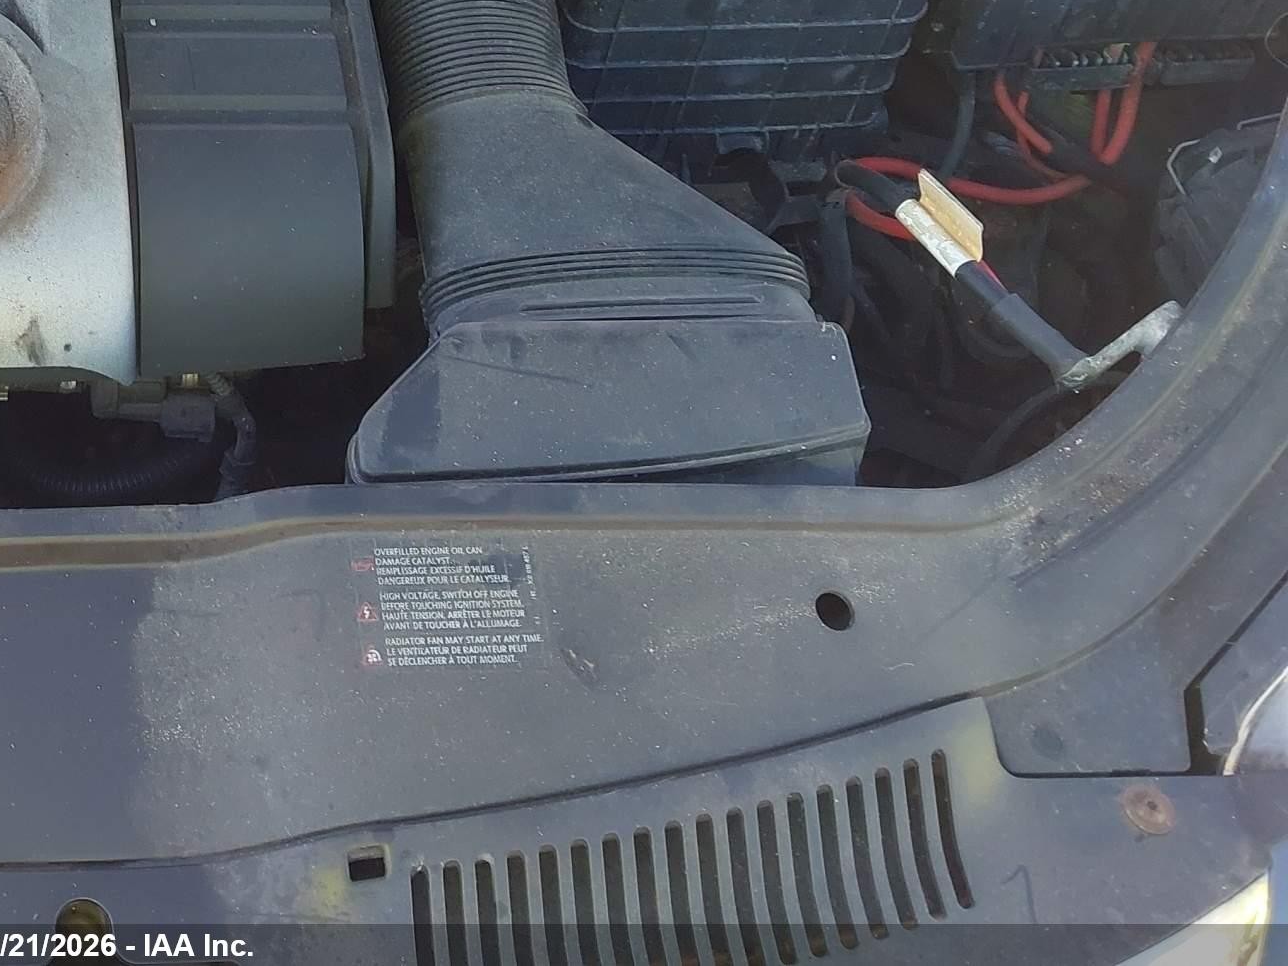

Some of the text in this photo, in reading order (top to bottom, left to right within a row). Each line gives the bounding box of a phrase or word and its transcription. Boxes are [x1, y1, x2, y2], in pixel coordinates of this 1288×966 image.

[374, 546, 483, 556] OVERFILLED ENGINE OIL CAN
[375, 557, 411, 566] DAMAGE
[376, 564, 496, 576] REMPLISSAGE EXCESSIF D'HUILE
[377, 576, 425, 585] DANGEREUX
[427, 576, 448, 584] POUR
[449, 575, 460, 584] LE
[379, 591, 401, 601] HIGH
[442, 590, 473, 599] SWITCH
[473, 590, 488, 598] OFF
[490, 589, 519, 598] ENGINE
[381, 602, 409, 611] BEFORE
[410, 601, 453, 610] TOUCHING
[454, 600, 490, 609] IGNITION
[382, 611, 408, 621] HAUTE
[447, 609, 481, 619] ARRÊTER
[482, 610, 491, 619] LE
[492, 609, 525, 618] MOTEUR
[383, 621, 410, 631] AVANT
[412, 621, 424, 630] DE
[425, 620, 460, 629] TOUCHER
[462, 619, 469, 628] À
[385, 636, 426, 646] RADIATOR
[427, 636, 444, 645] FAN
[445, 636, 464, 644] MAY
[465, 635, 490, 644] START
[492, 634, 502, 643] AT
[503, 634, 520, 643] ANY
[386, 644, 528, 656] LE VENTILATEUR DE RADIATEUR PEUT
[387, 657, 397, 667] SE
[398, 656, 447, 666] DÉCLENCHER
[448, 655, 455, 664] À
[456, 655, 478, 664] TOUT
